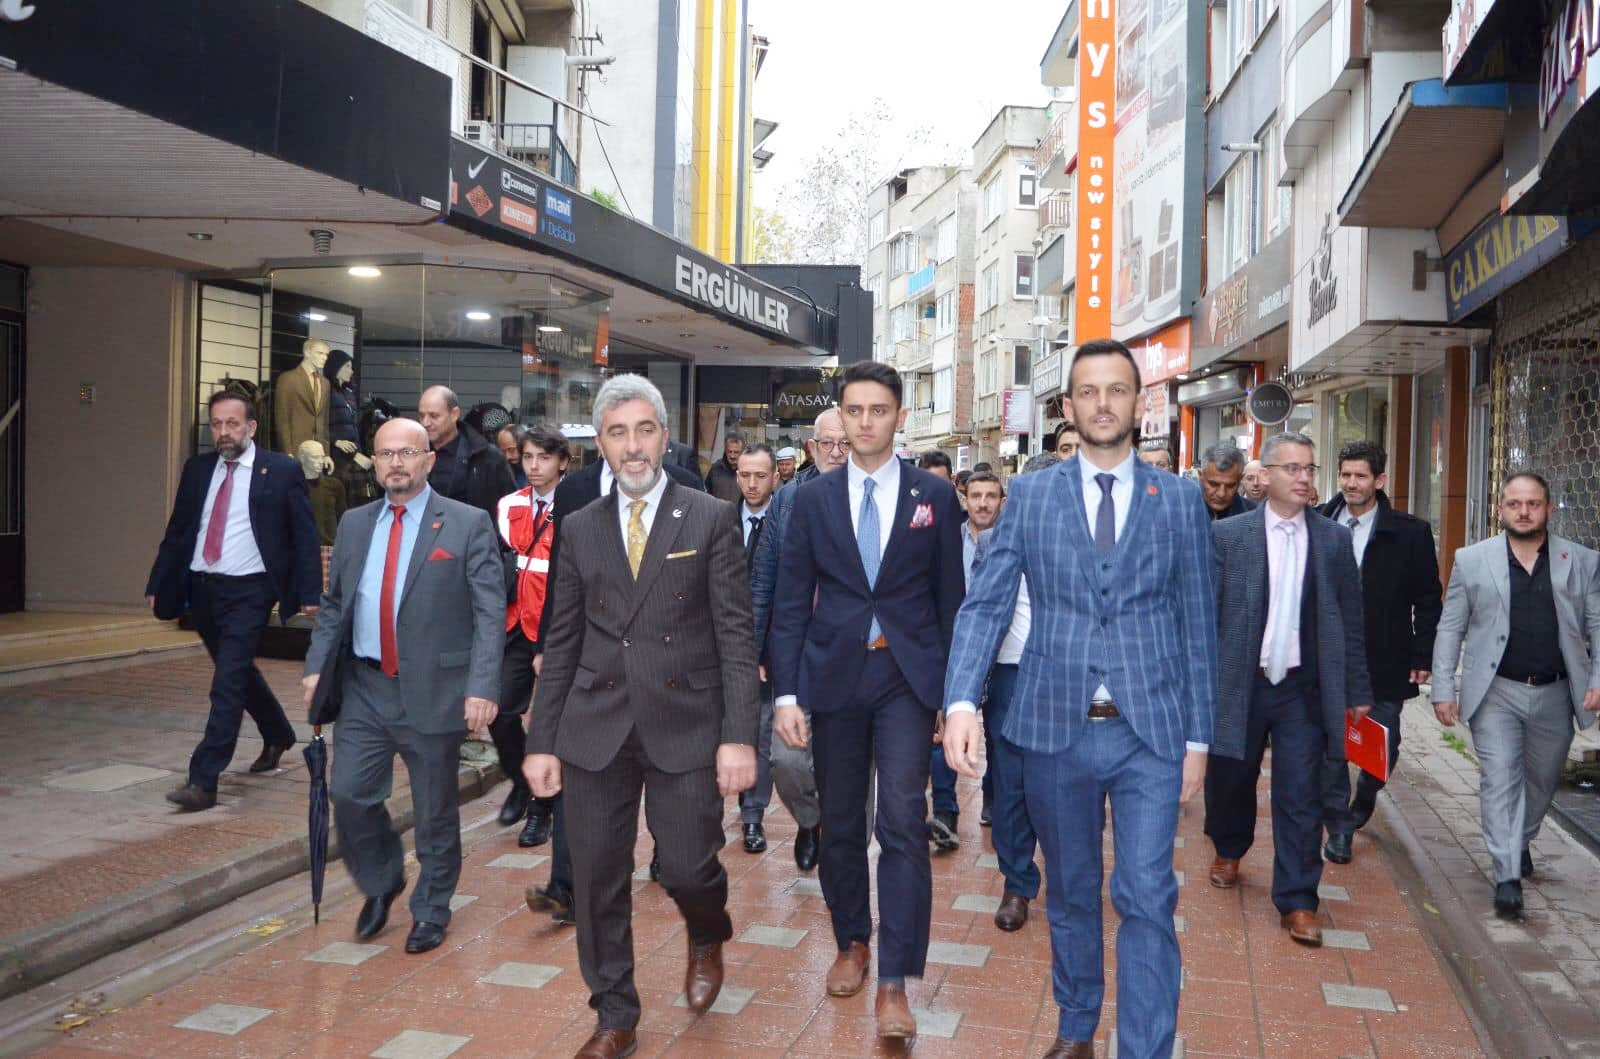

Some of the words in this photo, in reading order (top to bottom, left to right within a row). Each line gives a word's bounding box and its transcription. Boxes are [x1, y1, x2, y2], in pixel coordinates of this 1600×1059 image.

[1087, 155, 1105, 204] new
[547, 194, 571, 217] mavi
[1088, 217, 1103, 308] style
[675, 254, 790, 335] ERGÜNLER
[776, 392, 831, 407] ATASAY
